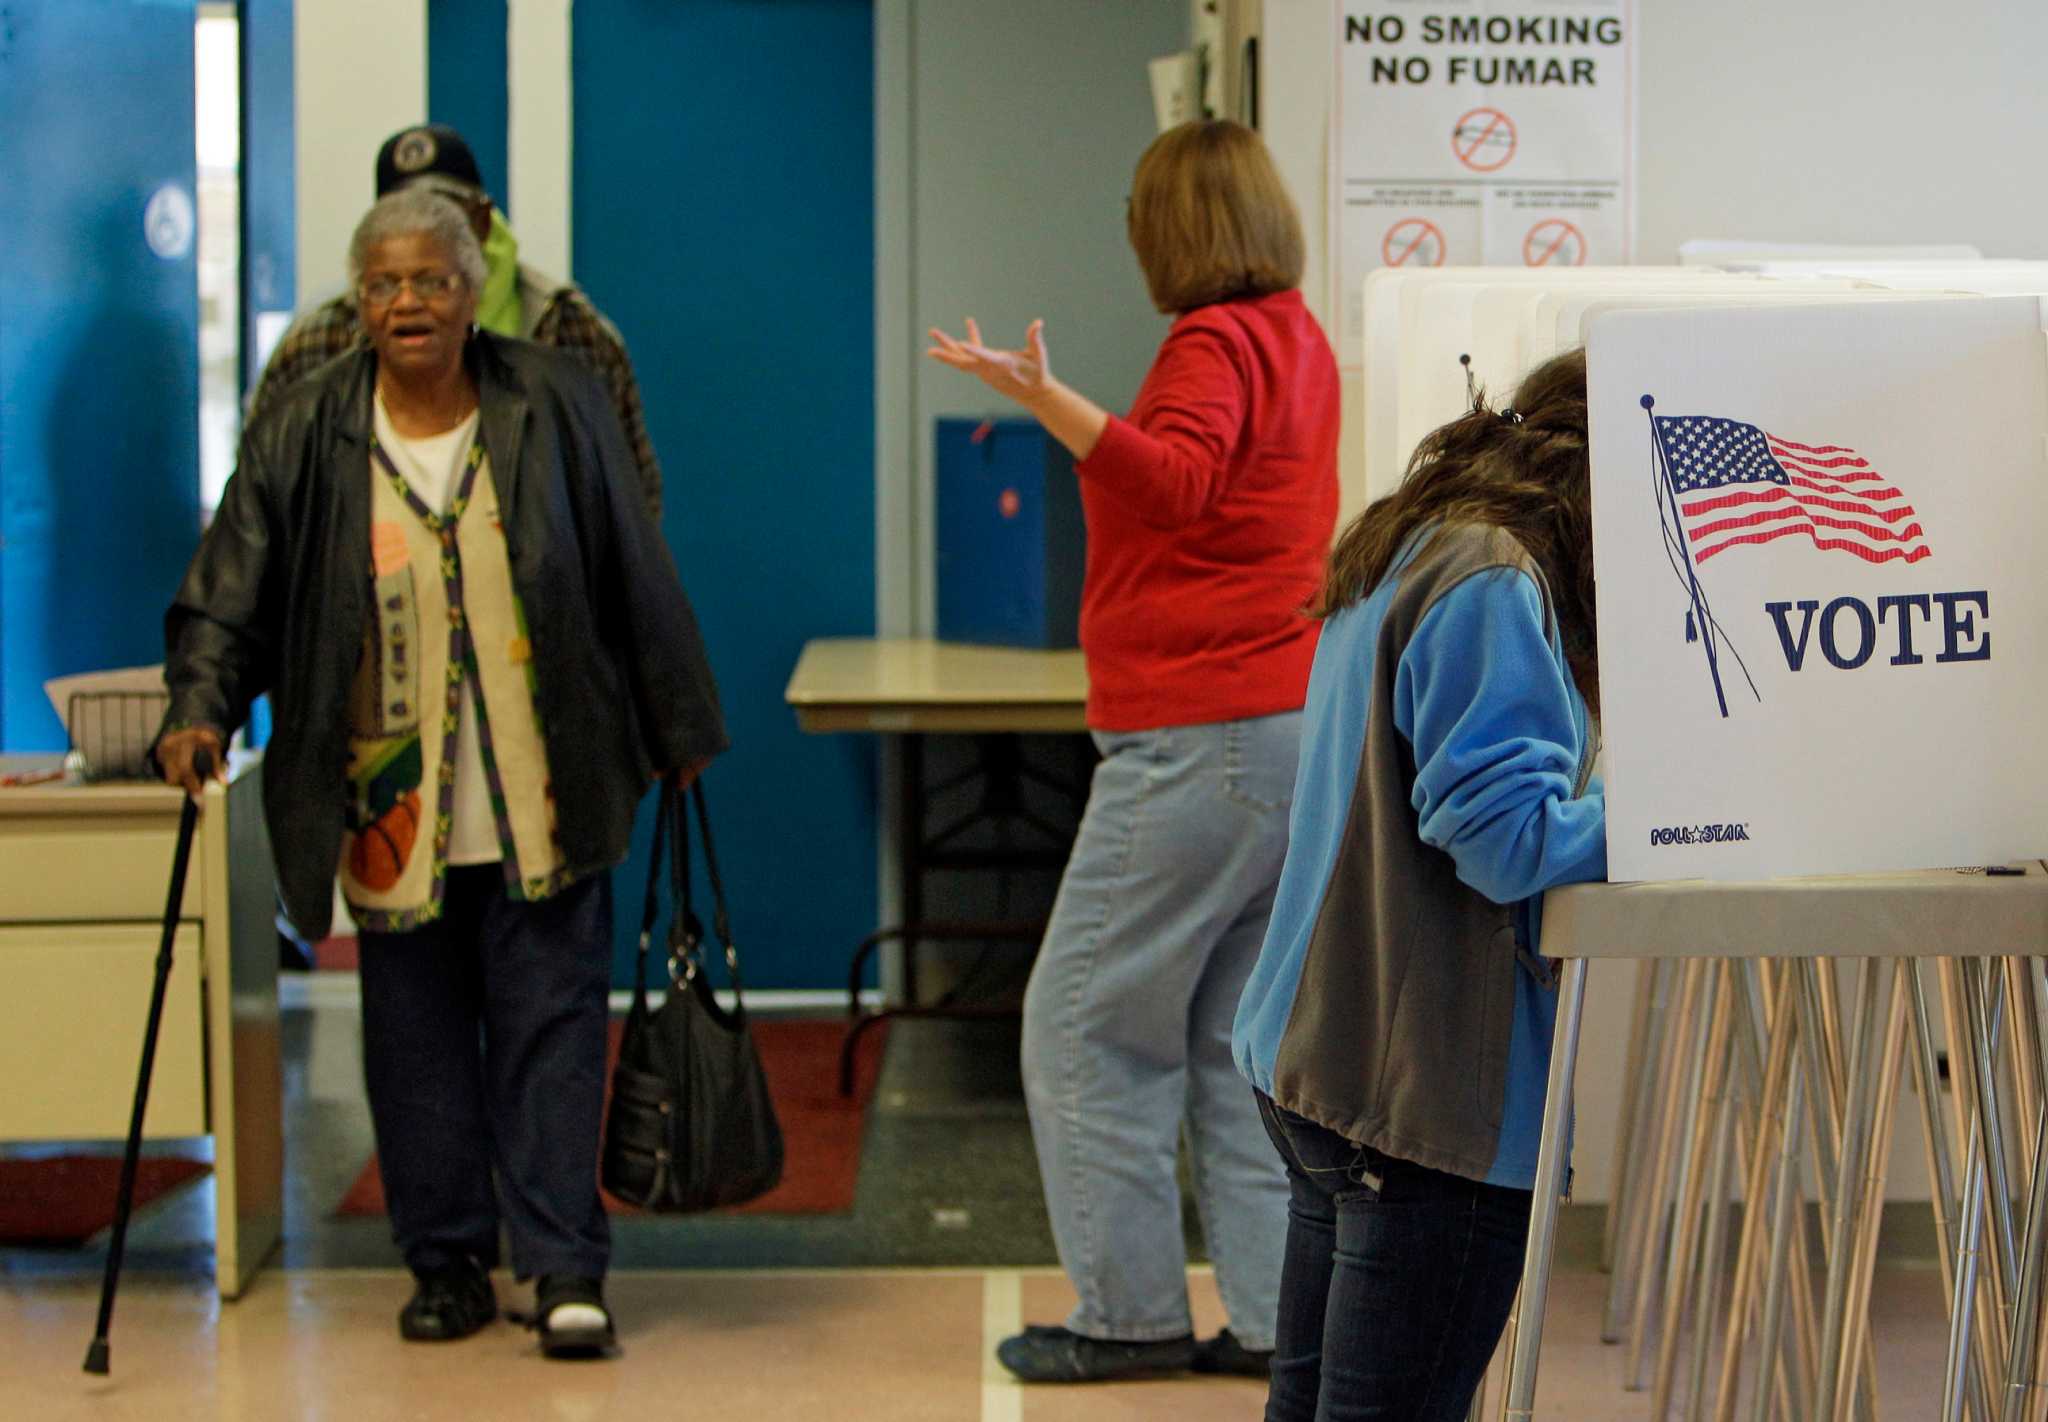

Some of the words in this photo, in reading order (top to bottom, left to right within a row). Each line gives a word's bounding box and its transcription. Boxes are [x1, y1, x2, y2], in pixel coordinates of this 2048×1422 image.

[1345, 15, 1406, 44] NO
[1421, 15, 1622, 45] SMOKING
[1372, 56, 1431, 85] NO
[1448, 57, 1596, 86] FUMAR
[1765, 590, 1991, 672] VOTE
